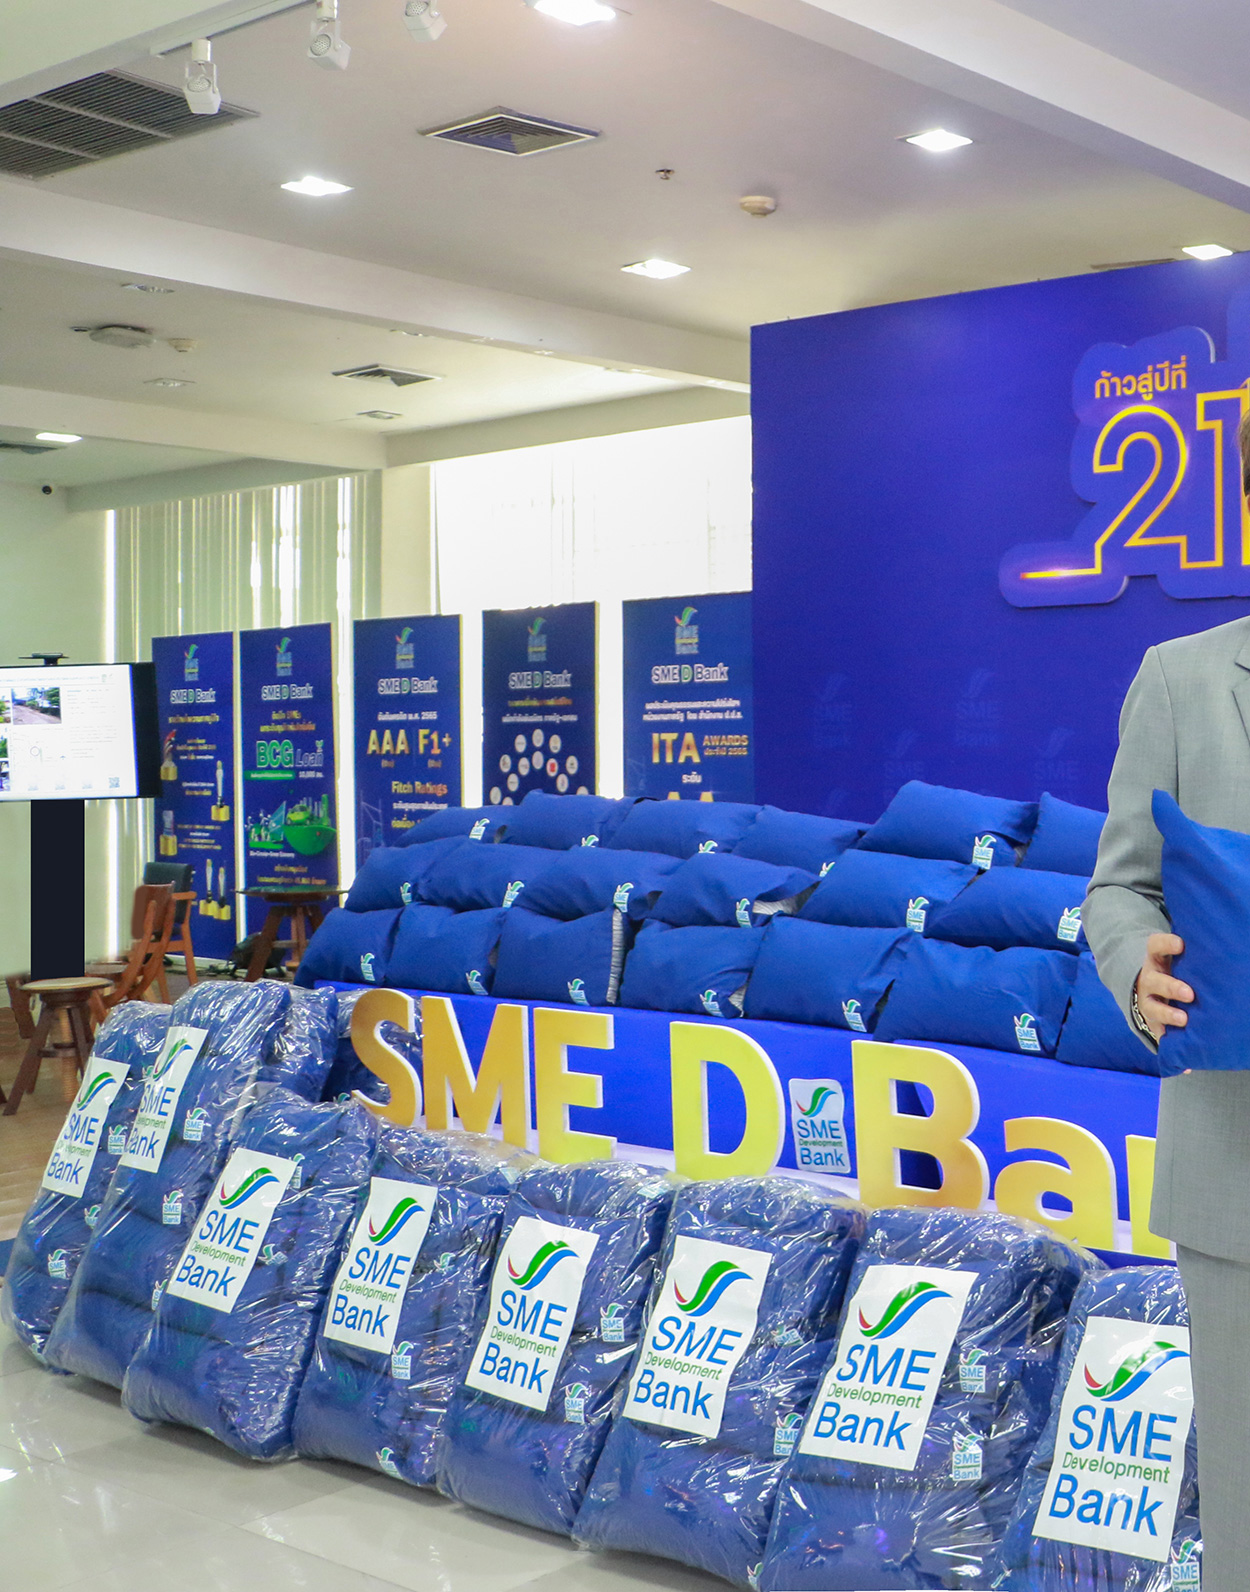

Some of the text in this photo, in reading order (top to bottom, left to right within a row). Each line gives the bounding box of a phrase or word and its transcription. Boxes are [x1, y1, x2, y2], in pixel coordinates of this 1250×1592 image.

[1094, 356, 1187, 401] ก้าวสู่ปีที่
[378, 678, 400, 695] SME
[411, 676, 438, 694] Bank
[509, 671, 532, 689] SME
[543, 669, 572, 688] Bank
[652, 662, 729, 683] SME D Bank
[257, 740, 294, 768] BCG
[367, 730, 410, 755] AAA
[652, 732, 701, 763] ITA
[703, 735, 748, 746] AWARDS
[415, 781, 448, 797] Ratings
[351, 988, 617, 1165] SME
[670, 1021, 786, 1181] D
[797, 1119, 841, 1139] SME
[799, 1139, 843, 1147] Development
[47, 1152, 83, 1184] Bank
[800, 1148, 845, 1167] Bank
[199, 1210, 259, 1253] SME
[189, 1241, 247, 1267] Development
[176, 1255, 237, 1297] Bank
[349, 1247, 411, 1289] SME
[339, 1279, 397, 1304] Development
[331, 1294, 390, 1338] Bank
[497, 1290, 568, 1342] SME
[601, 1319, 620, 1328] SME
[490, 1326, 558, 1358] Development
[603, 1333, 622, 1341] Bank
[652, 1316, 742, 1366] SME
[393, 1356, 410, 1366] SME
[479, 1342, 549, 1394] Bank
[644, 1351, 722, 1381] Development
[836, 1343, 937, 1391] SME
[960, 1367, 984, 1377] SME
[633, 1369, 714, 1419] Bank
[827, 1383, 923, 1408] Development
[962, 1381, 983, 1391] Bank
[813, 1401, 912, 1451] Bank
[1069, 1404, 1177, 1462] SME
[954, 1452, 980, 1465] SME
[1062, 1451, 1170, 1484] Development
[954, 1468, 979, 1479] Bank
[1048, 1473, 1163, 1537] Bank
[1173, 1565, 1198, 1580] SME
